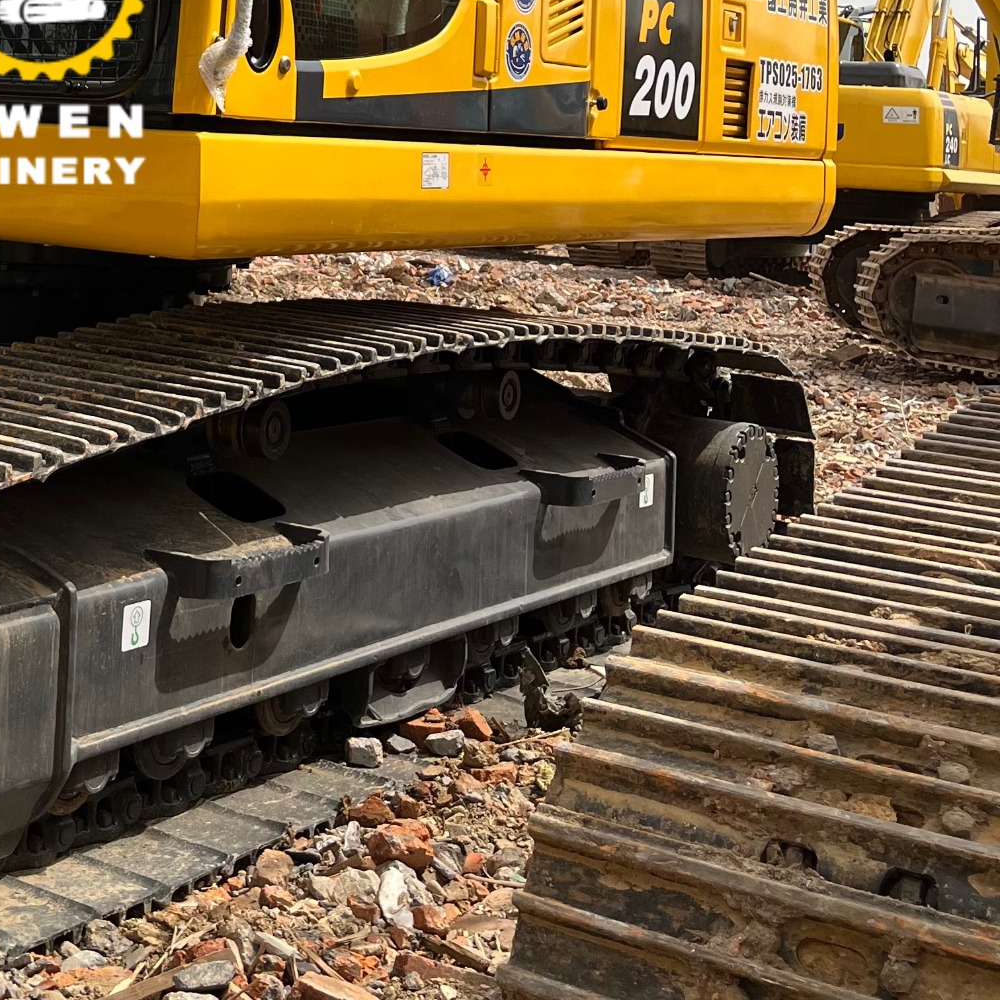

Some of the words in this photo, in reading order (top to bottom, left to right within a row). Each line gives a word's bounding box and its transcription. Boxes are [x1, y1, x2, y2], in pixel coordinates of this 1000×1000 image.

[628, 54, 696, 120] 200
[760, 59, 823, 91] TPS025-1763
[945, 136, 958, 154] 240
